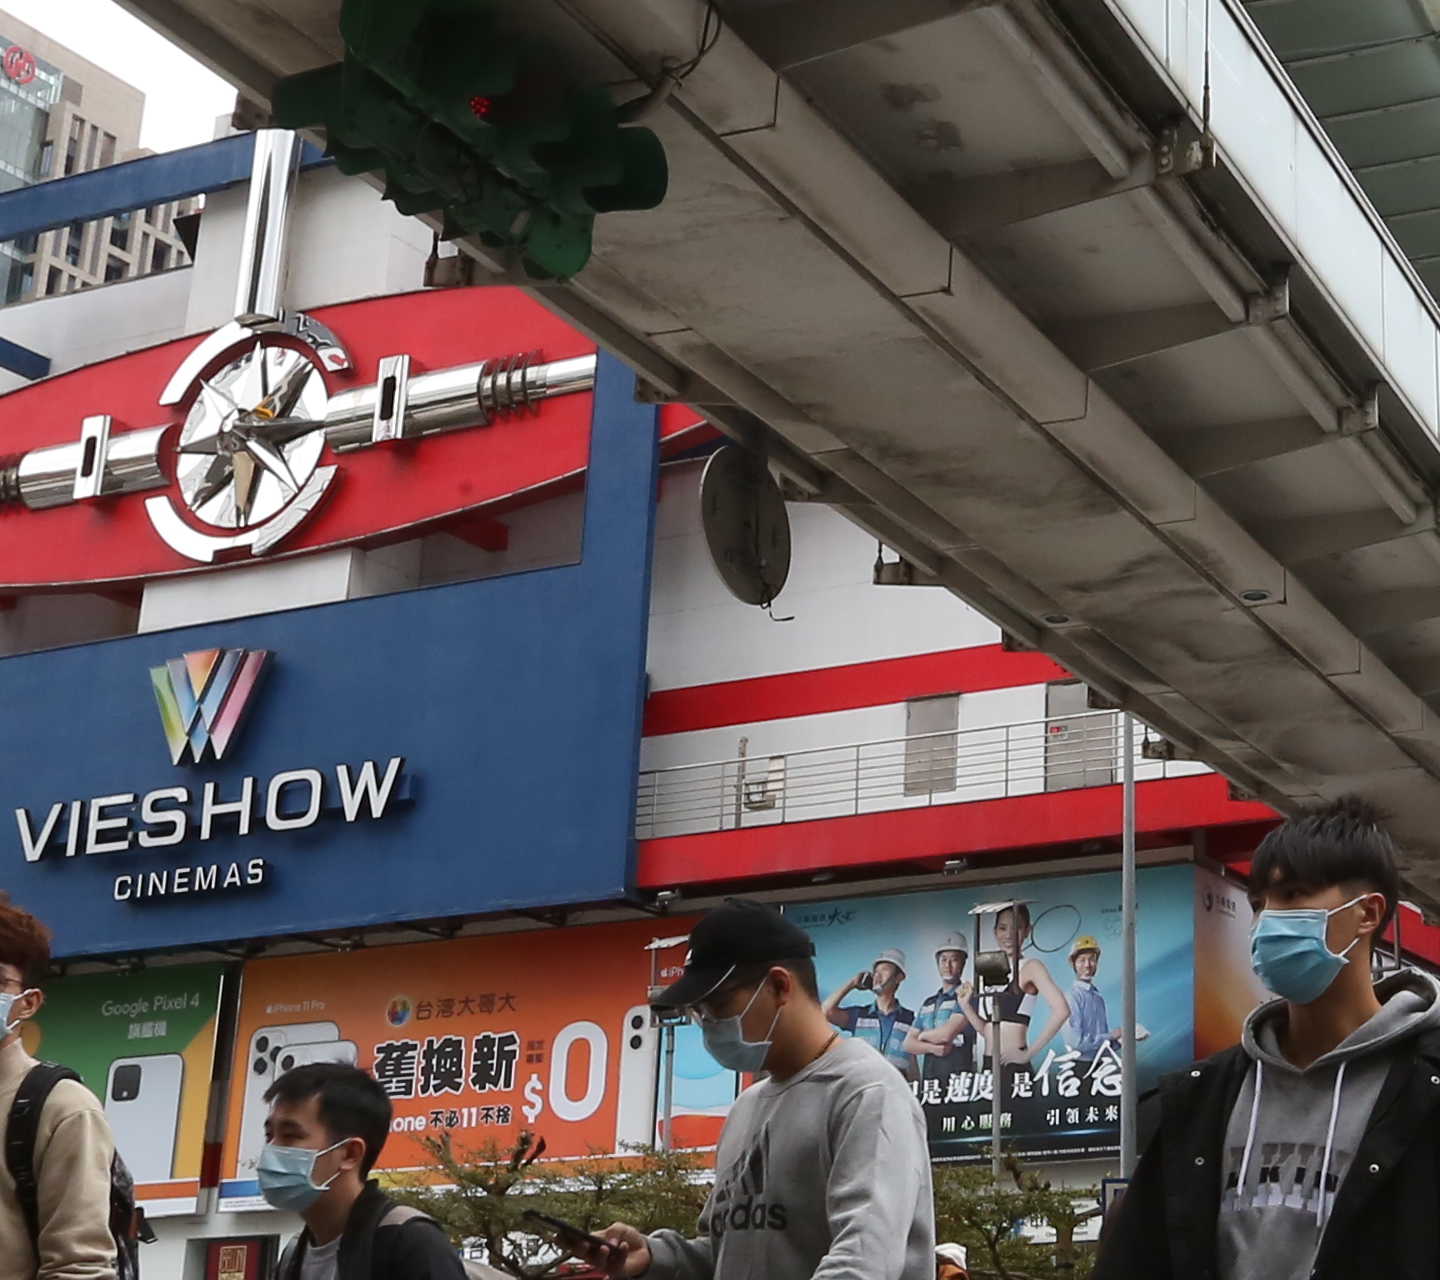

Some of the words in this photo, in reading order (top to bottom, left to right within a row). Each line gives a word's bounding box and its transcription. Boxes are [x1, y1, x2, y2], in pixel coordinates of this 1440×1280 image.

[14, 756, 402, 862] VIESHOW
[113, 858, 265, 902] CINEMAS
[102, 999, 150, 1018] Google
[154, 996, 186, 1012] Pixel
[189, 993, 201, 1008] 4
[373, 1030, 522, 1099] 舊換新
